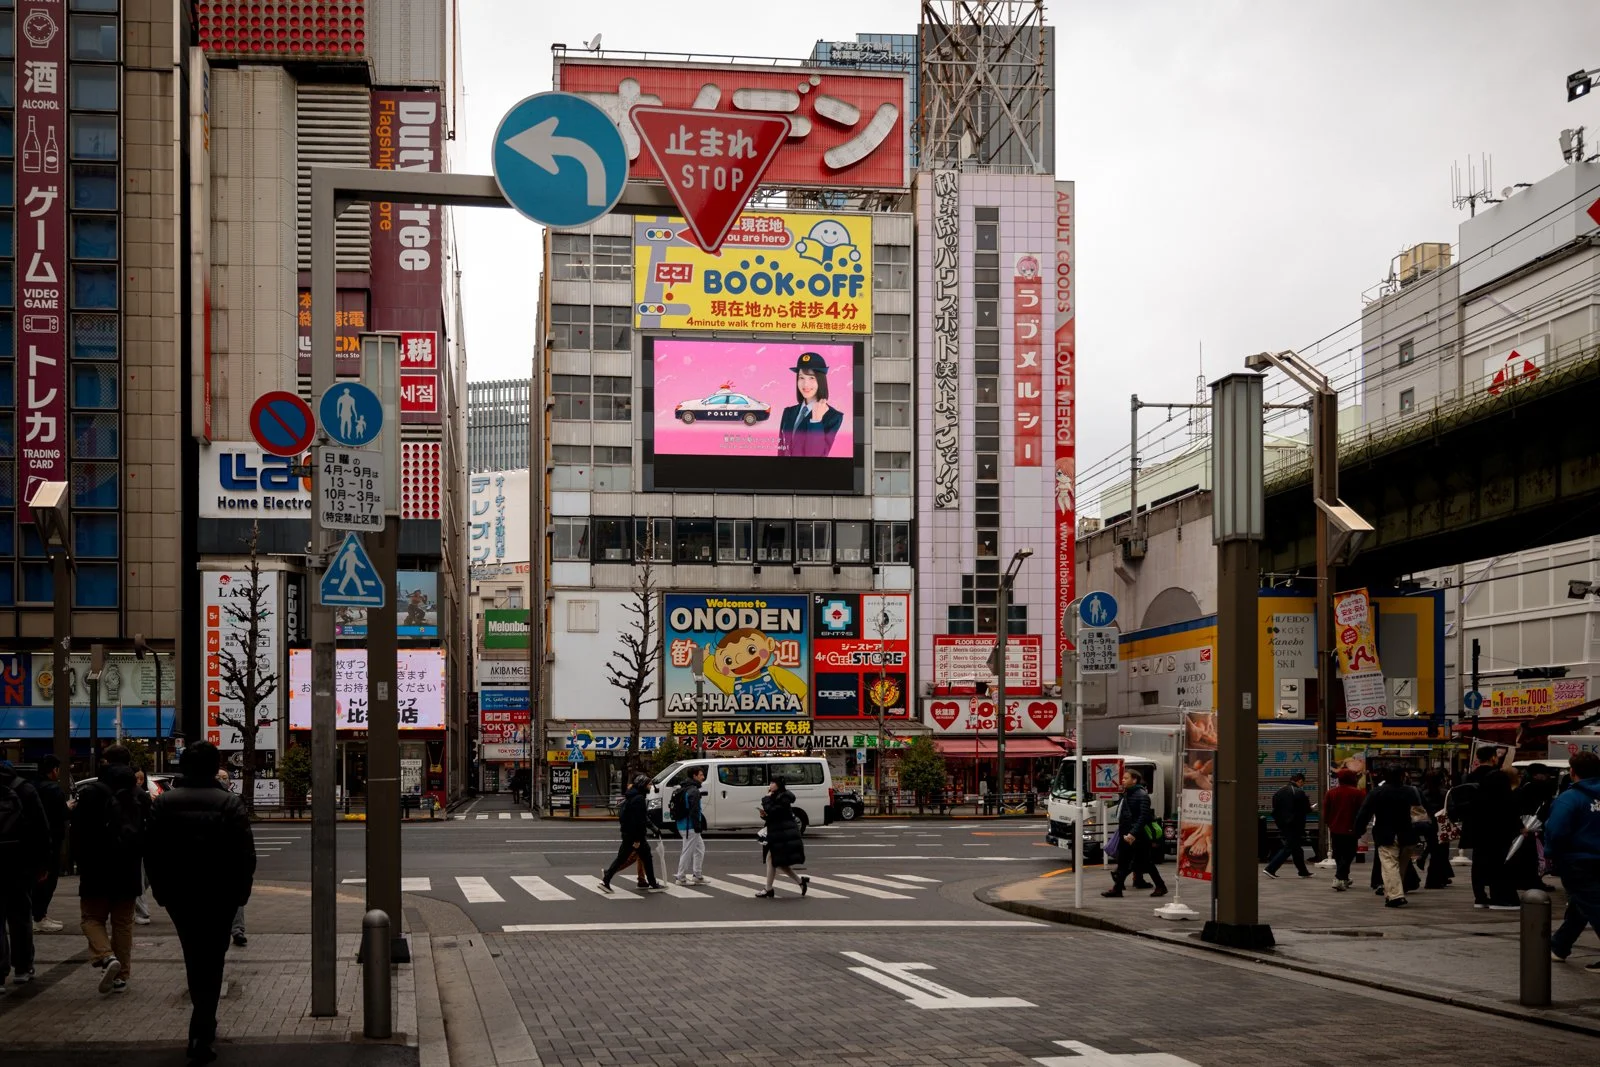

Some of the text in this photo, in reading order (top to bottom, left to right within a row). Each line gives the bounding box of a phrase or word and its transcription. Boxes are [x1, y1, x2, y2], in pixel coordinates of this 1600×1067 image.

[24, 60, 58, 94] 酒
[23, 100, 60, 110] ALCOHOL
[665, 124, 758, 160] 止まれ
[681, 163, 744, 192] STOP
[24, 186, 58, 282] ゲーム
[726, 233, 786, 244] ou are here
[1056, 190, 1071, 313] ADULT GOODS
[24, 289, 59, 299] VIDEO
[24, 299, 59, 309] GAME
[711, 300, 858, 320] 現在地から徒歩4分
[728, 318, 748, 328] walk
[751, 319, 773, 329] from
[775, 320, 796, 329] here
[1016, 287, 1041, 460] ラブメルシー
[26, 345, 58, 442] トレカ
[1057, 342, 1072, 446] LOVE MERCI
[23, 449, 60, 459] TRADING
[325, 453, 361, 466] 日曜の
[30, 459, 54, 469] CARD
[217, 496, 258, 509] Home
[705, 598, 767, 609] Welcome to
[815, 595, 825, 604] 5F
[670, 607, 801, 631] ONODEN
[815, 652, 827, 661] 4F
[481, 723, 516, 732] TOKYO
[728, 722, 752, 734] TAX
[754, 722, 783, 734] FREE
[784, 721, 811, 735] 免税
[737, 736, 793, 748] ONODEN
[796, 736, 848, 748] CAMERA
